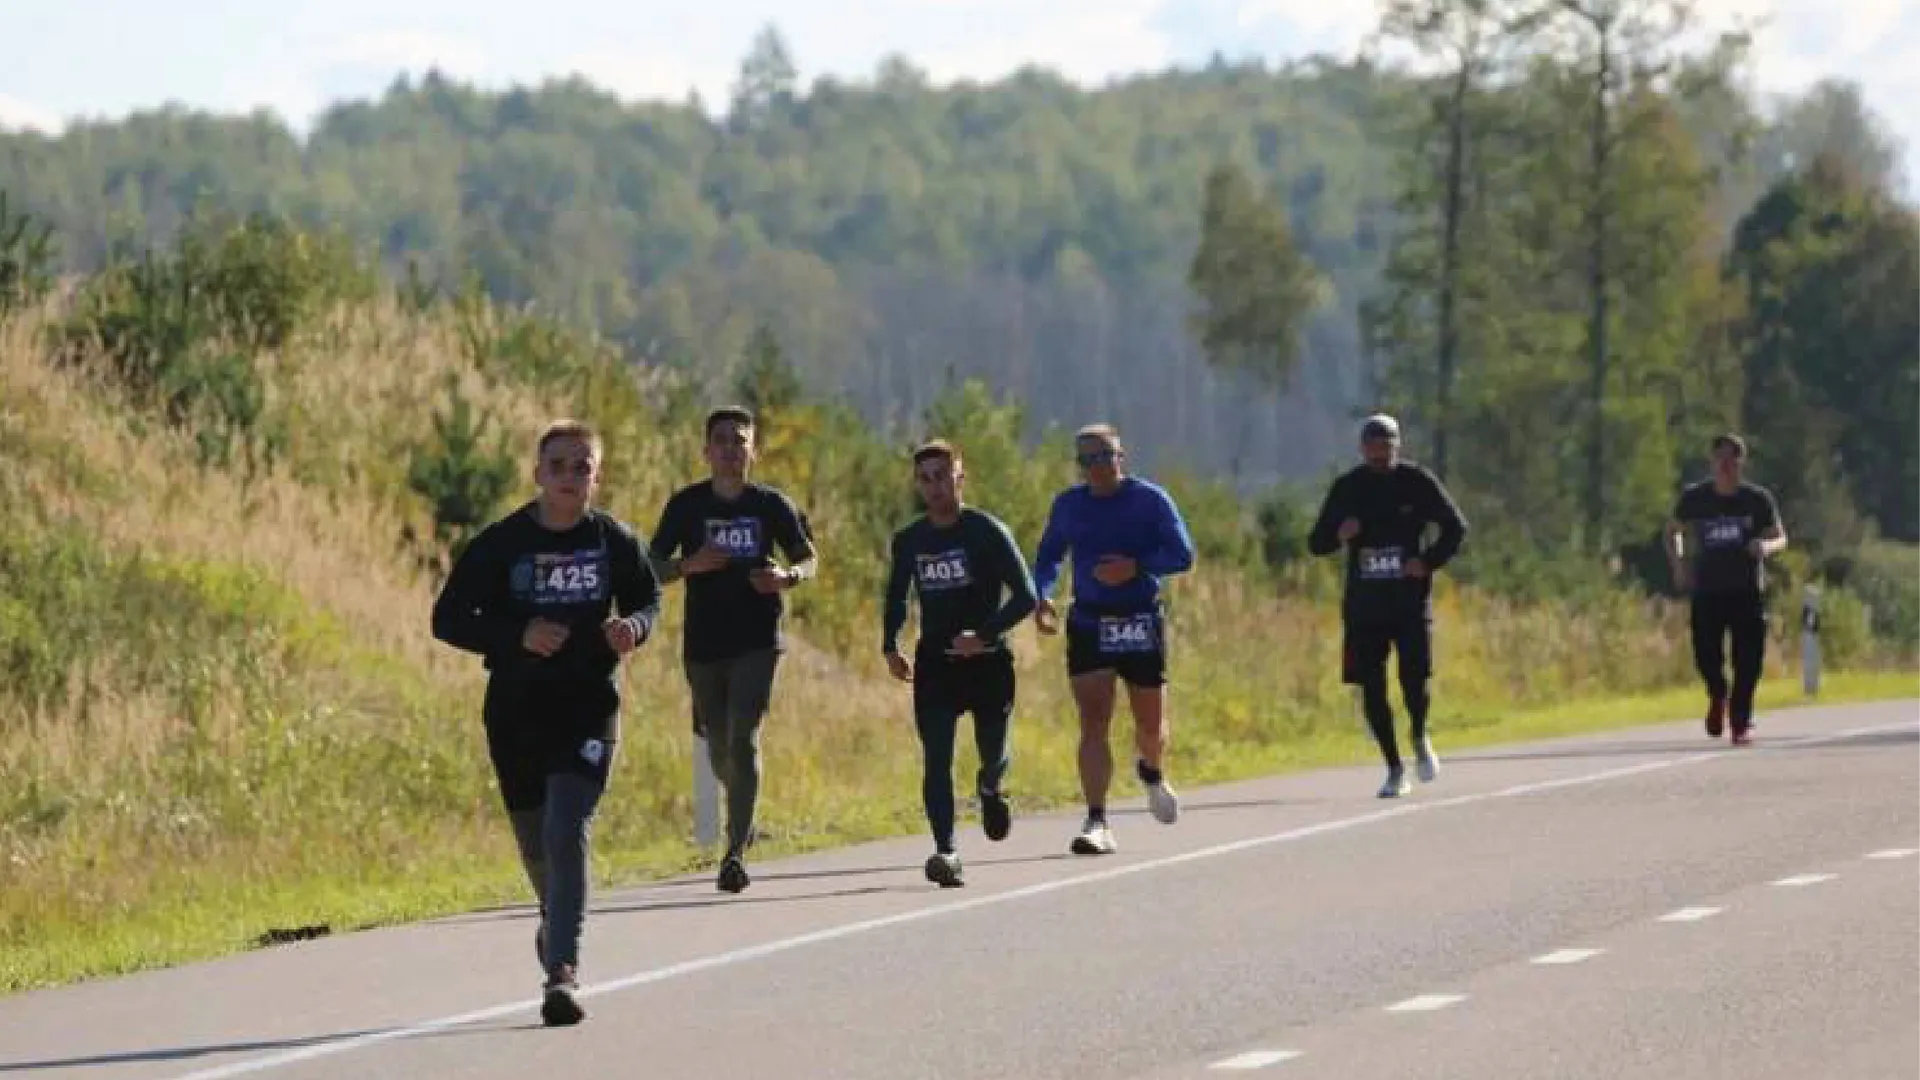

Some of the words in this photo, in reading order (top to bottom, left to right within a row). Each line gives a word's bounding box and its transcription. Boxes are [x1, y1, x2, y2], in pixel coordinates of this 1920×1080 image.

[714, 528, 754, 548] 401
[547, 564, 598, 589] 425
[924, 560, 965, 580] 403
[1106, 621, 1148, 643] 346
